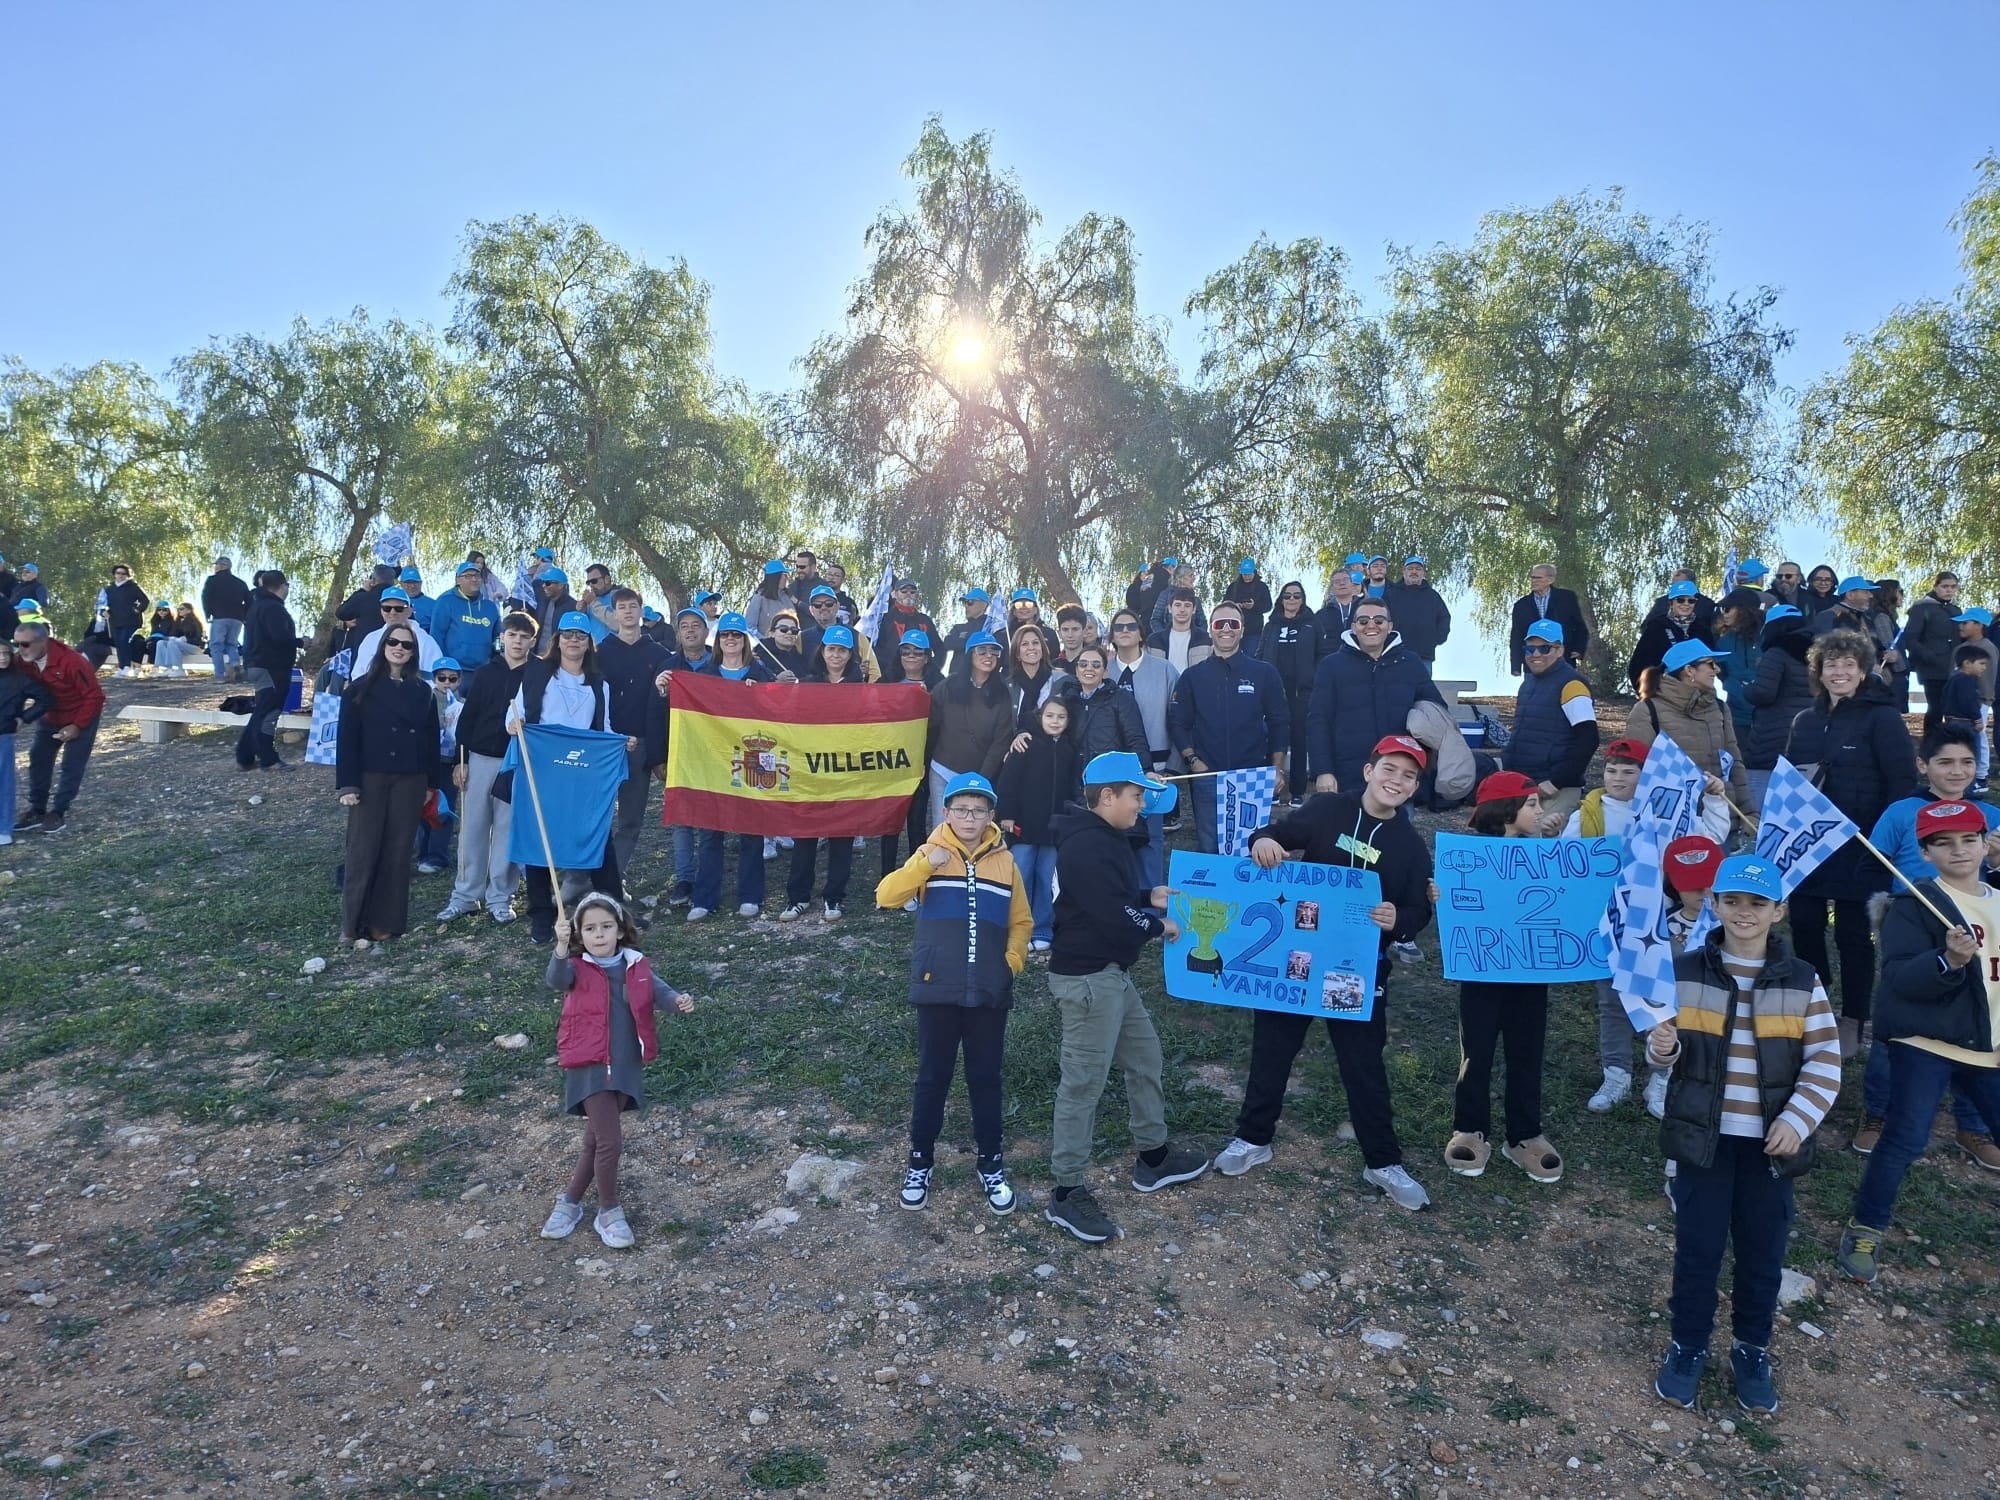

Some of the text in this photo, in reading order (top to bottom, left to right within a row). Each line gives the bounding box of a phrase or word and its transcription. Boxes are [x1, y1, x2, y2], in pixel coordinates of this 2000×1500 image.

[805, 748, 911, 774] VILLENA
[1225, 779, 1237, 856] ARNEDO
[1233, 859, 1364, 888] GANADOR
[1485, 838, 1622, 880] VAMOS
[968, 897, 977, 909] IT
[1515, 885, 1561, 925] 2
[967, 911, 977, 963] HAPPEN
[1224, 901, 1284, 978] 2
